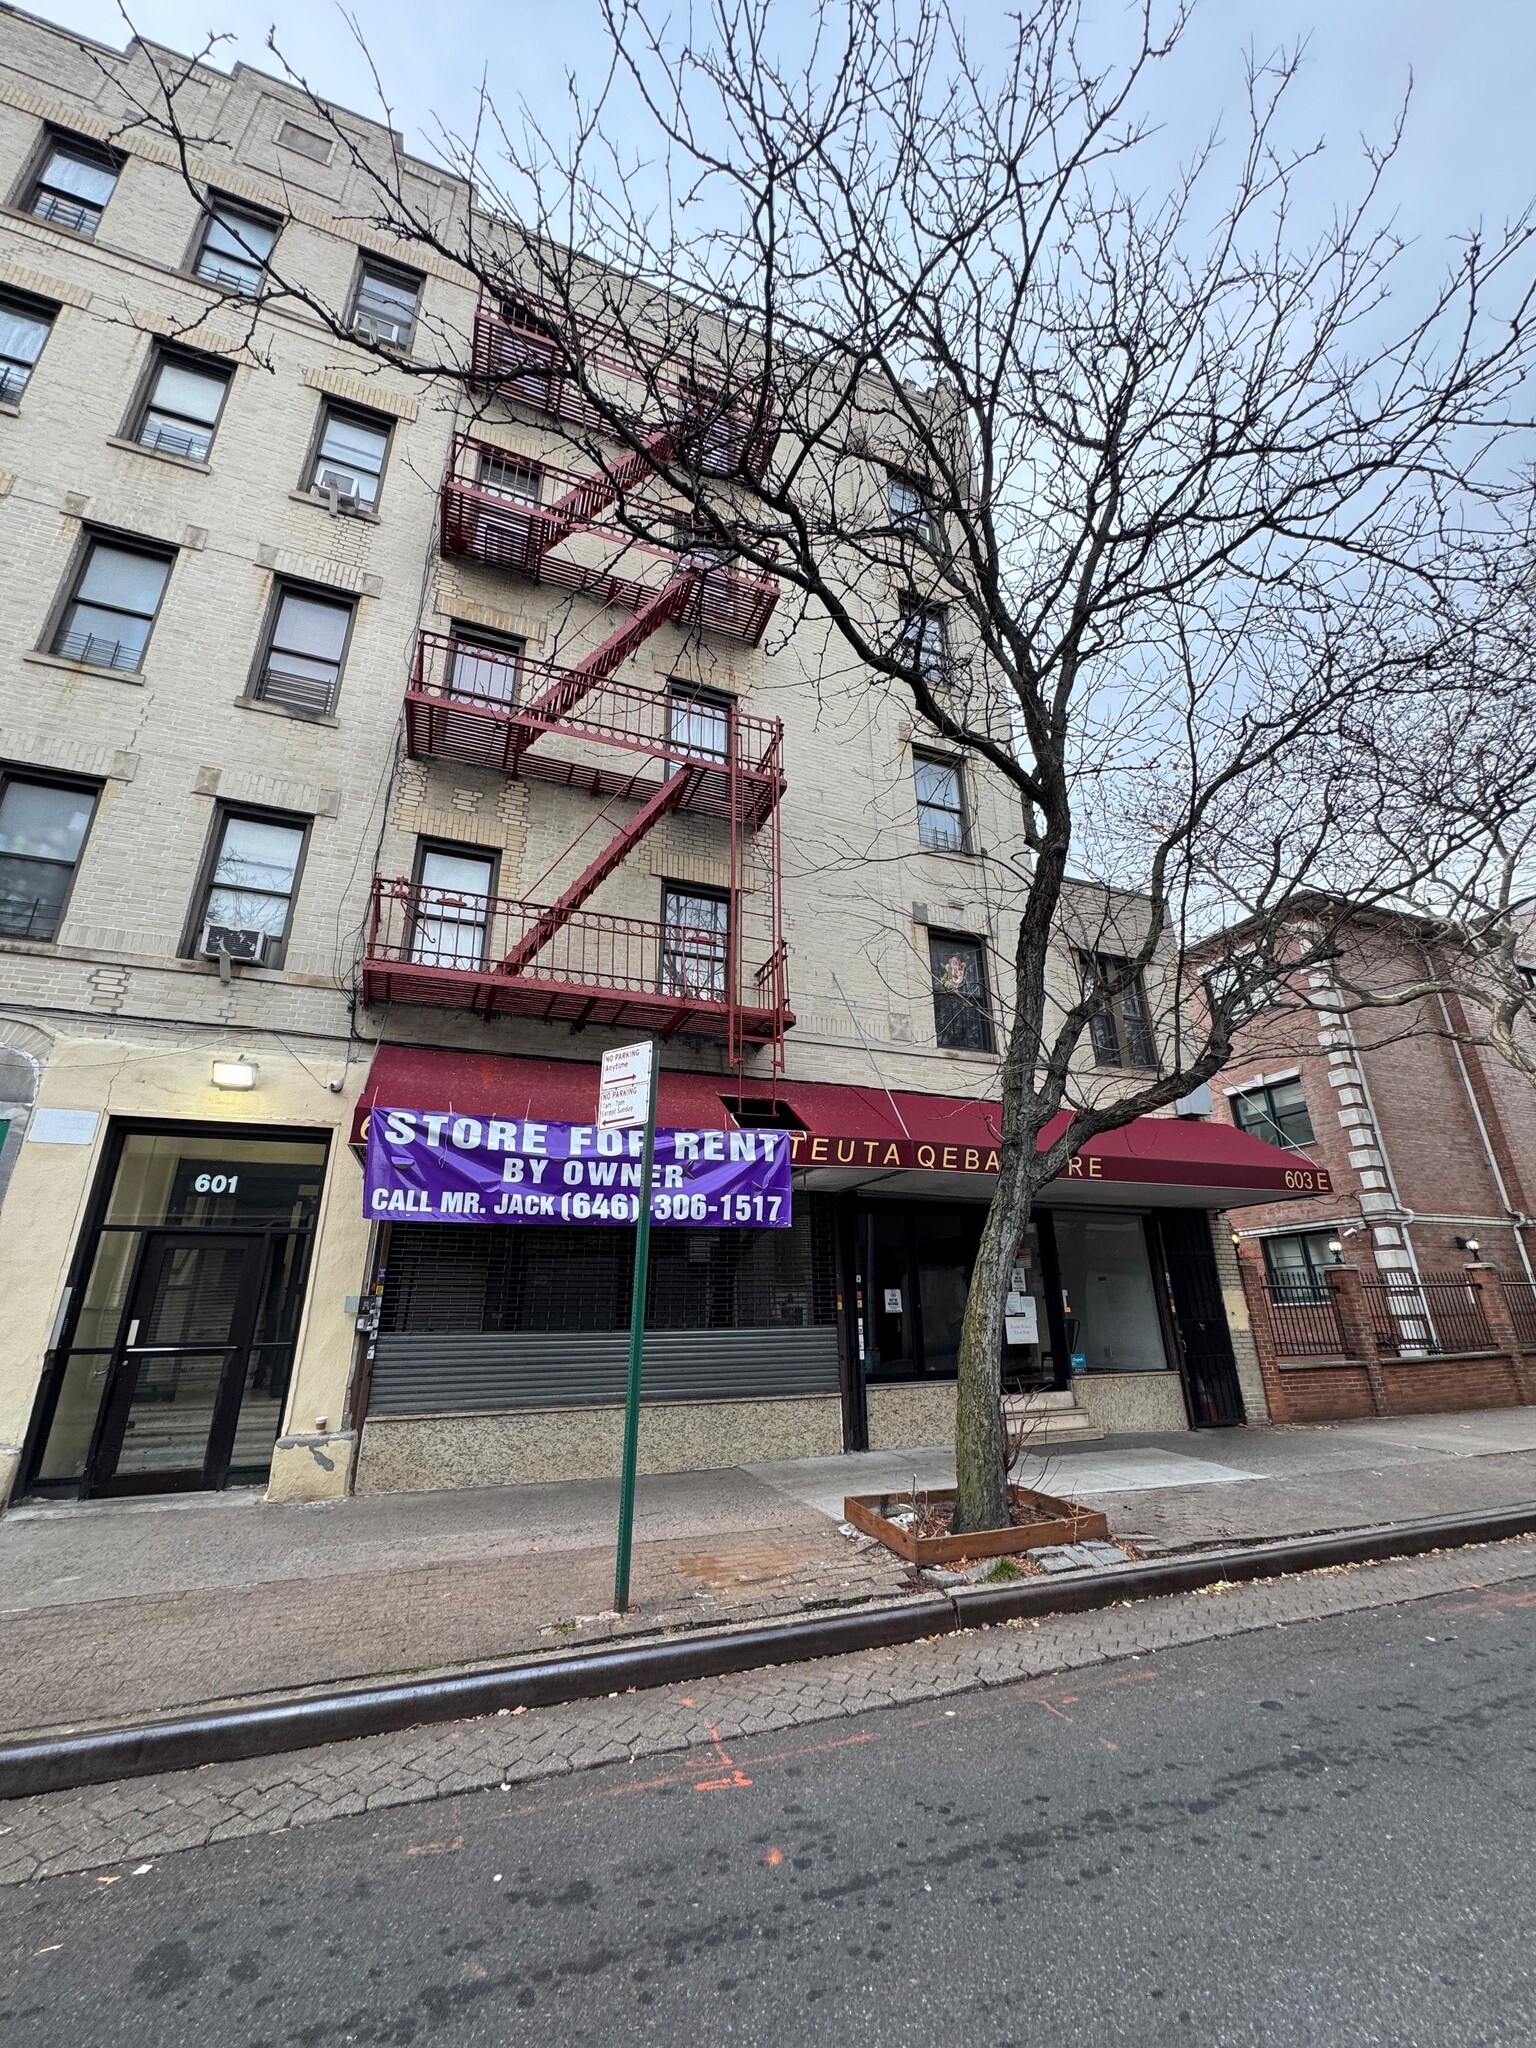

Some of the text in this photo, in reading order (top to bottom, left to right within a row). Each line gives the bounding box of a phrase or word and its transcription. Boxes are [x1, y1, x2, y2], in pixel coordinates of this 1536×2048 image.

[605, 1049, 640, 1063] NO PARKING
[605, 1061, 628, 1072] Anytime
[602, 1087, 637, 1101] NO PARKING
[617, 1106, 633, 1114] Sunday
[384, 1112, 548, 1154] STORE
[674, 1132, 778, 1162] RENT
[790, 1136, 901, 1166] TEUTA
[502, 1158, 684, 1188] BY OWNER
[1285, 1170, 1329, 1190] 603 E
[194, 1174, 238, 1194] 601
[371, 1188, 433, 1213] CALL
[440, 1191, 486, 1214] MR.
[494, 1193, 555, 1216] JACK
